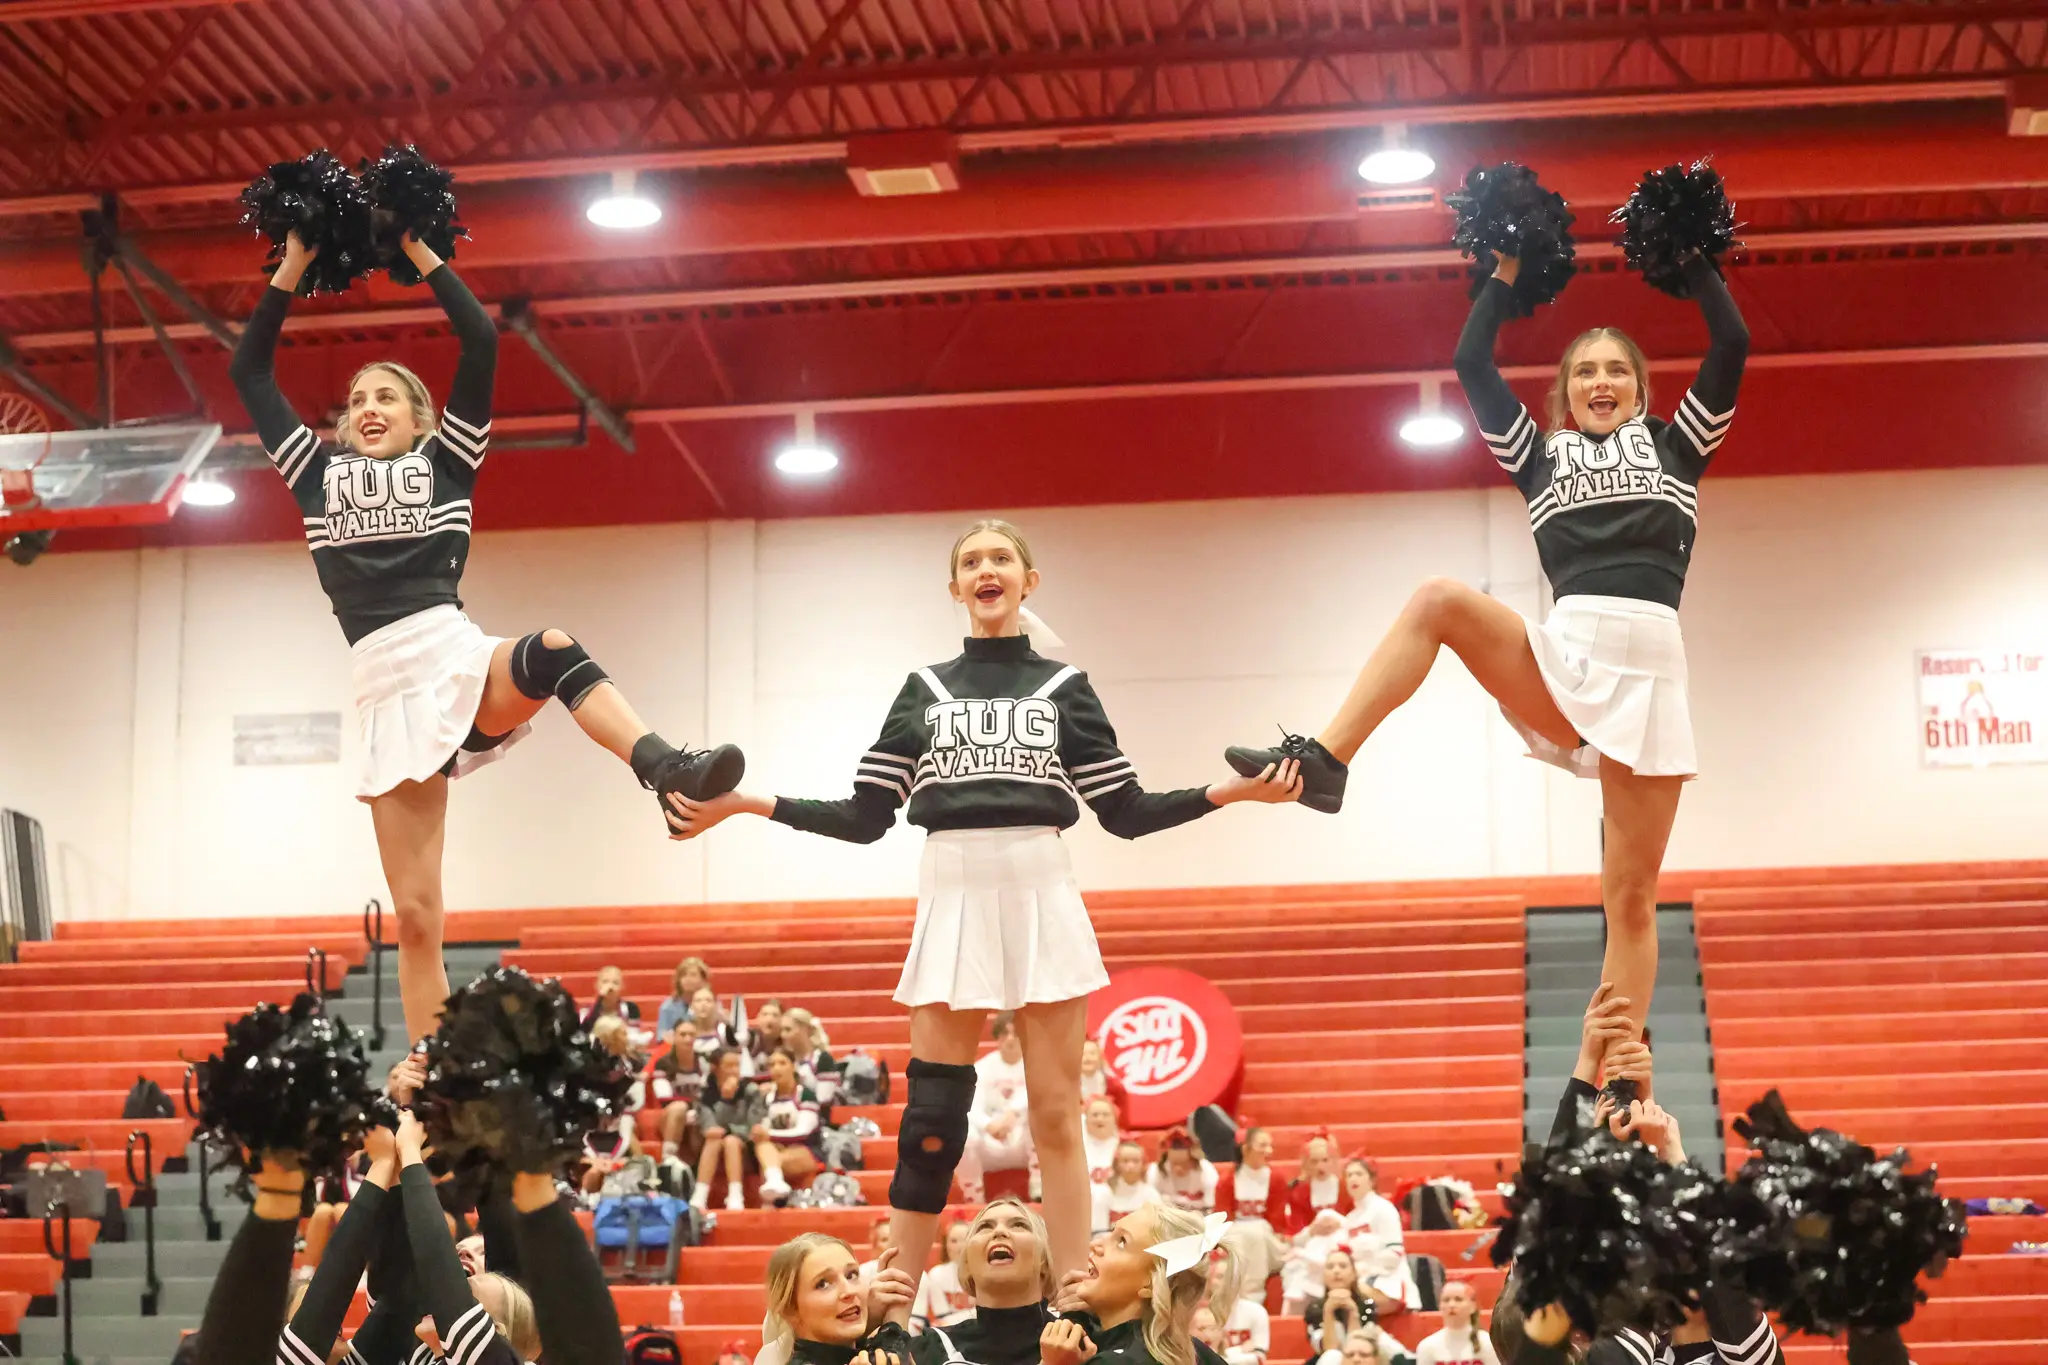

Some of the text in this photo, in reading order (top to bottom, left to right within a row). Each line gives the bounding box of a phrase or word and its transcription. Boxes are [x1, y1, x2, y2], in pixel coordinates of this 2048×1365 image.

[1546, 421, 1662, 481] TUG
[324, 454, 433, 516] TUG
[1552, 468, 1663, 507] VALLEY
[326, 506, 430, 542] VALLEY
[925, 697, 1058, 750] TUG
[1925, 716, 2032, 749] 6th Man
[932, 747, 1052, 778] VALLEY
